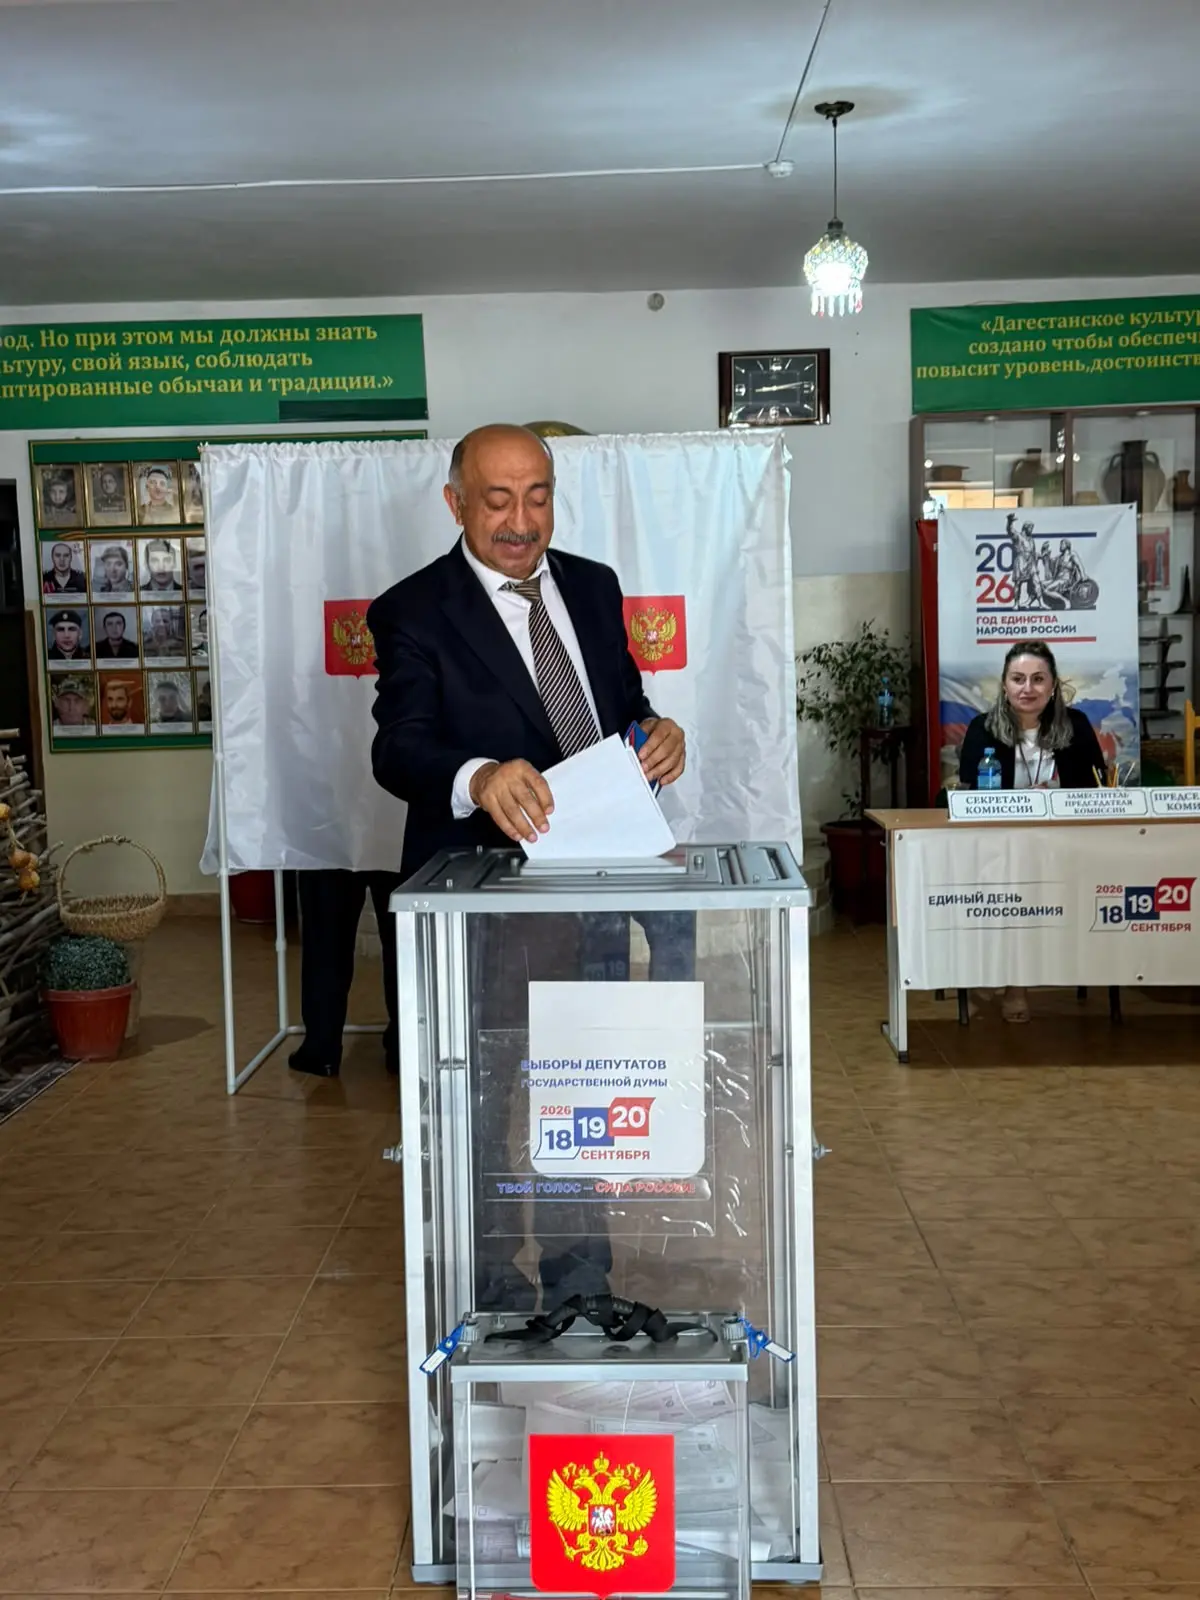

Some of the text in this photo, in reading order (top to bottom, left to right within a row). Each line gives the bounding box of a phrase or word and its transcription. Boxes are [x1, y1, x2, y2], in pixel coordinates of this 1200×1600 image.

[981, 312, 1125, 335] «Дагестанское
[0, 326, 378, 352] од. Но при этом мы должны знать
[968, 330, 1200, 357] создано чтобы обеспеч
[0, 350, 313, 378] ьтуру, свой язык, соблюдать
[915, 363, 1000, 379] повысит
[0, 375, 394, 403] птированные обычаи и традиции.»
[975, 542, 1015, 573] 20
[975, 574, 1015, 604] 26
[976, 615, 1059, 626] ГОД ЕДИНСТВА
[976, 625, 1077, 636] НАРОДОВ РОССИИ
[965, 795, 1032, 805] СЕКРЕТАРЬ
[1154, 792, 1200, 801] ПРЕДСЕ
[965, 805, 1034, 815] КОМИССИИ
[1096, 885, 1123, 893] 2026
[928, 891, 1022, 906] ЕДИНЫЙ ДЕНЬ
[1100, 885, 1189, 924] 18 19 20
[966, 906, 1064, 917] ГОЛОСОВАНИЯ
[1130, 923, 1192, 932] СЕНТЯБРЯ
[520, 1059, 666, 1071] ВЫБОРЫ ДЕПУТАТОВ
[520, 1076, 668, 1088] ГОСУДАРСТВЕННОЙ ДУМЫ
[540, 1106, 572, 1115] 2026
[544, 1106, 646, 1150] 18 19 20
[580, 1150, 651, 1160] СЕНТЯБРЯ
[496, 1181, 533, 1194] ТВОЙ
[536, 1183, 581, 1194] ГОЛОС
[594, 1183, 633, 1194] СИЛА
